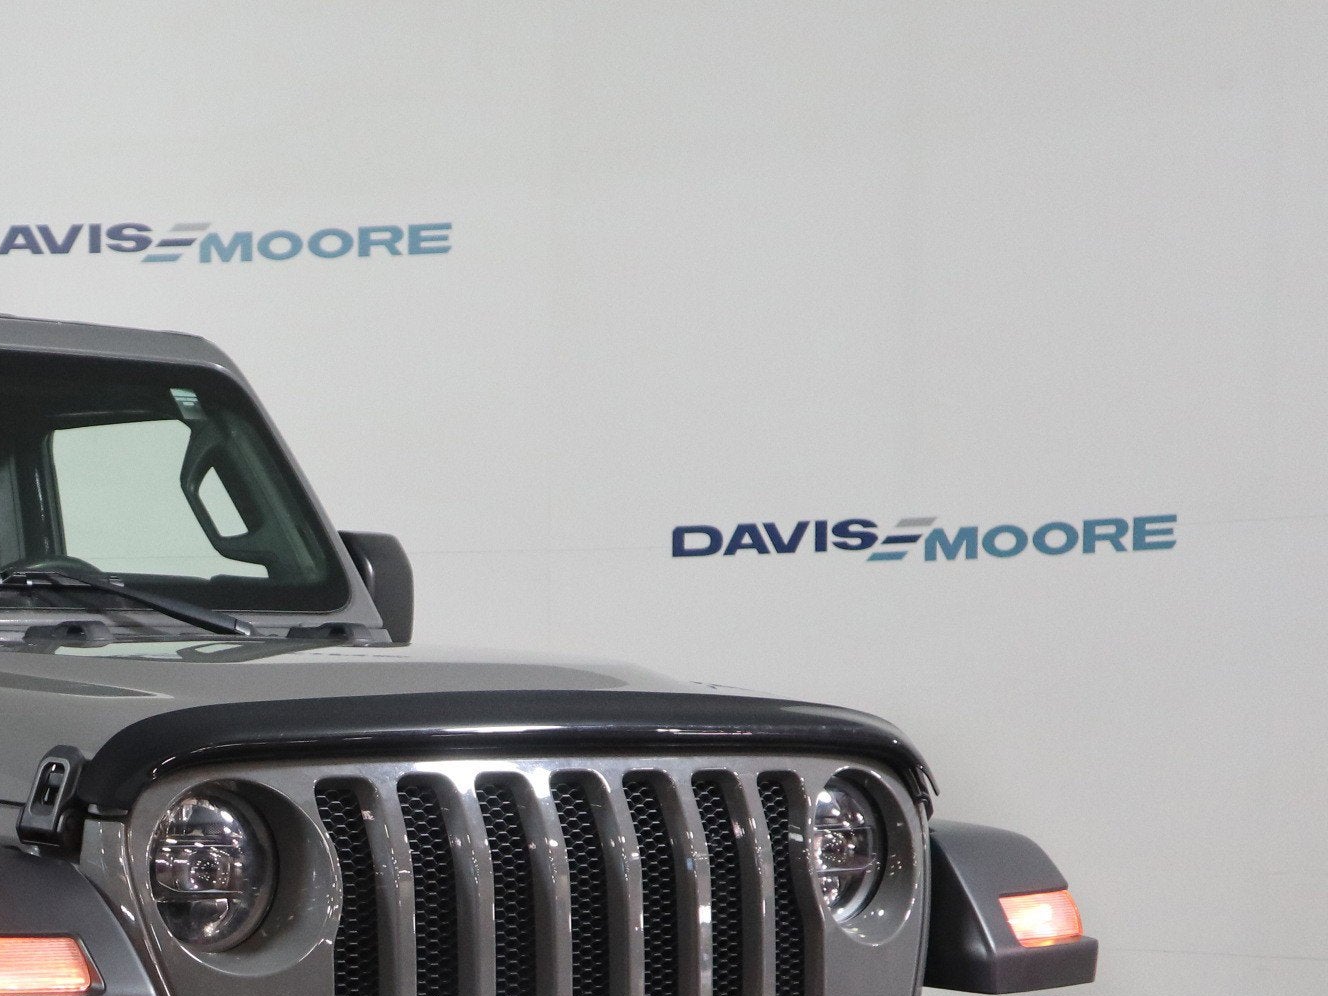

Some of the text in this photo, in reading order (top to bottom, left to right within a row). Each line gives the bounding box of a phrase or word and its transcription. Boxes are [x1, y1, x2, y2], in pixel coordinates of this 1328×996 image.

[199, 222, 453, 264] MOORE
[672, 514, 1178, 562] DAVIS MOORE
